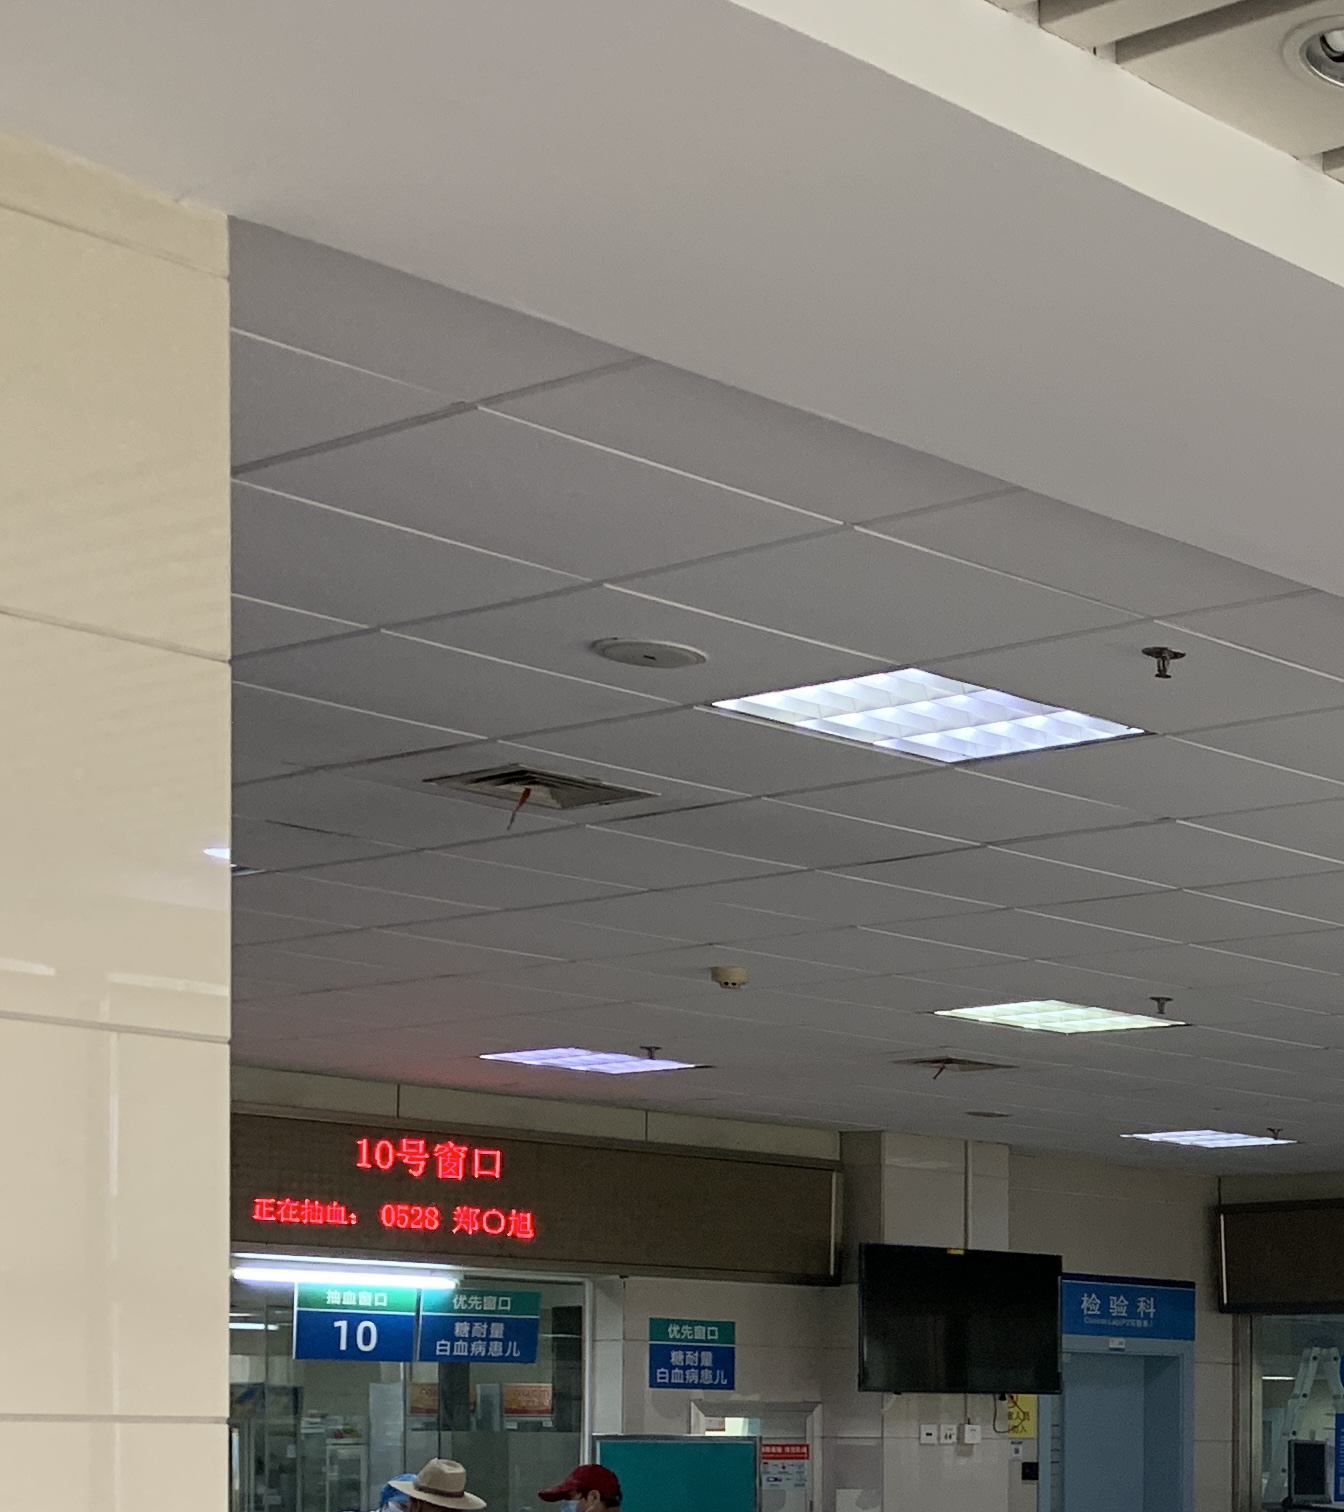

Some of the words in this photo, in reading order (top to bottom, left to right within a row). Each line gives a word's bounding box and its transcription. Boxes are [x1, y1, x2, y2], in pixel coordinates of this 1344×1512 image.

[356, 1138, 501, 1180] 10号窗口
[379, 1203, 441, 1231] 0528
[326, 1289, 388, 1306] 抽血窗口
[453, 1294, 511, 1311] 优先窗口
[1081, 1293, 1156, 1318] 检验科
[333, 1320, 378, 1352] 10
[454, 1321, 505, 1339] 糖耐量
[668, 1323, 719, 1340] 优先窗口
[436, 1340, 521, 1357] 白血病患儿
[670, 1350, 713, 1367] 糖耐量
[656, 1368, 728, 1385] 白血病患儿
